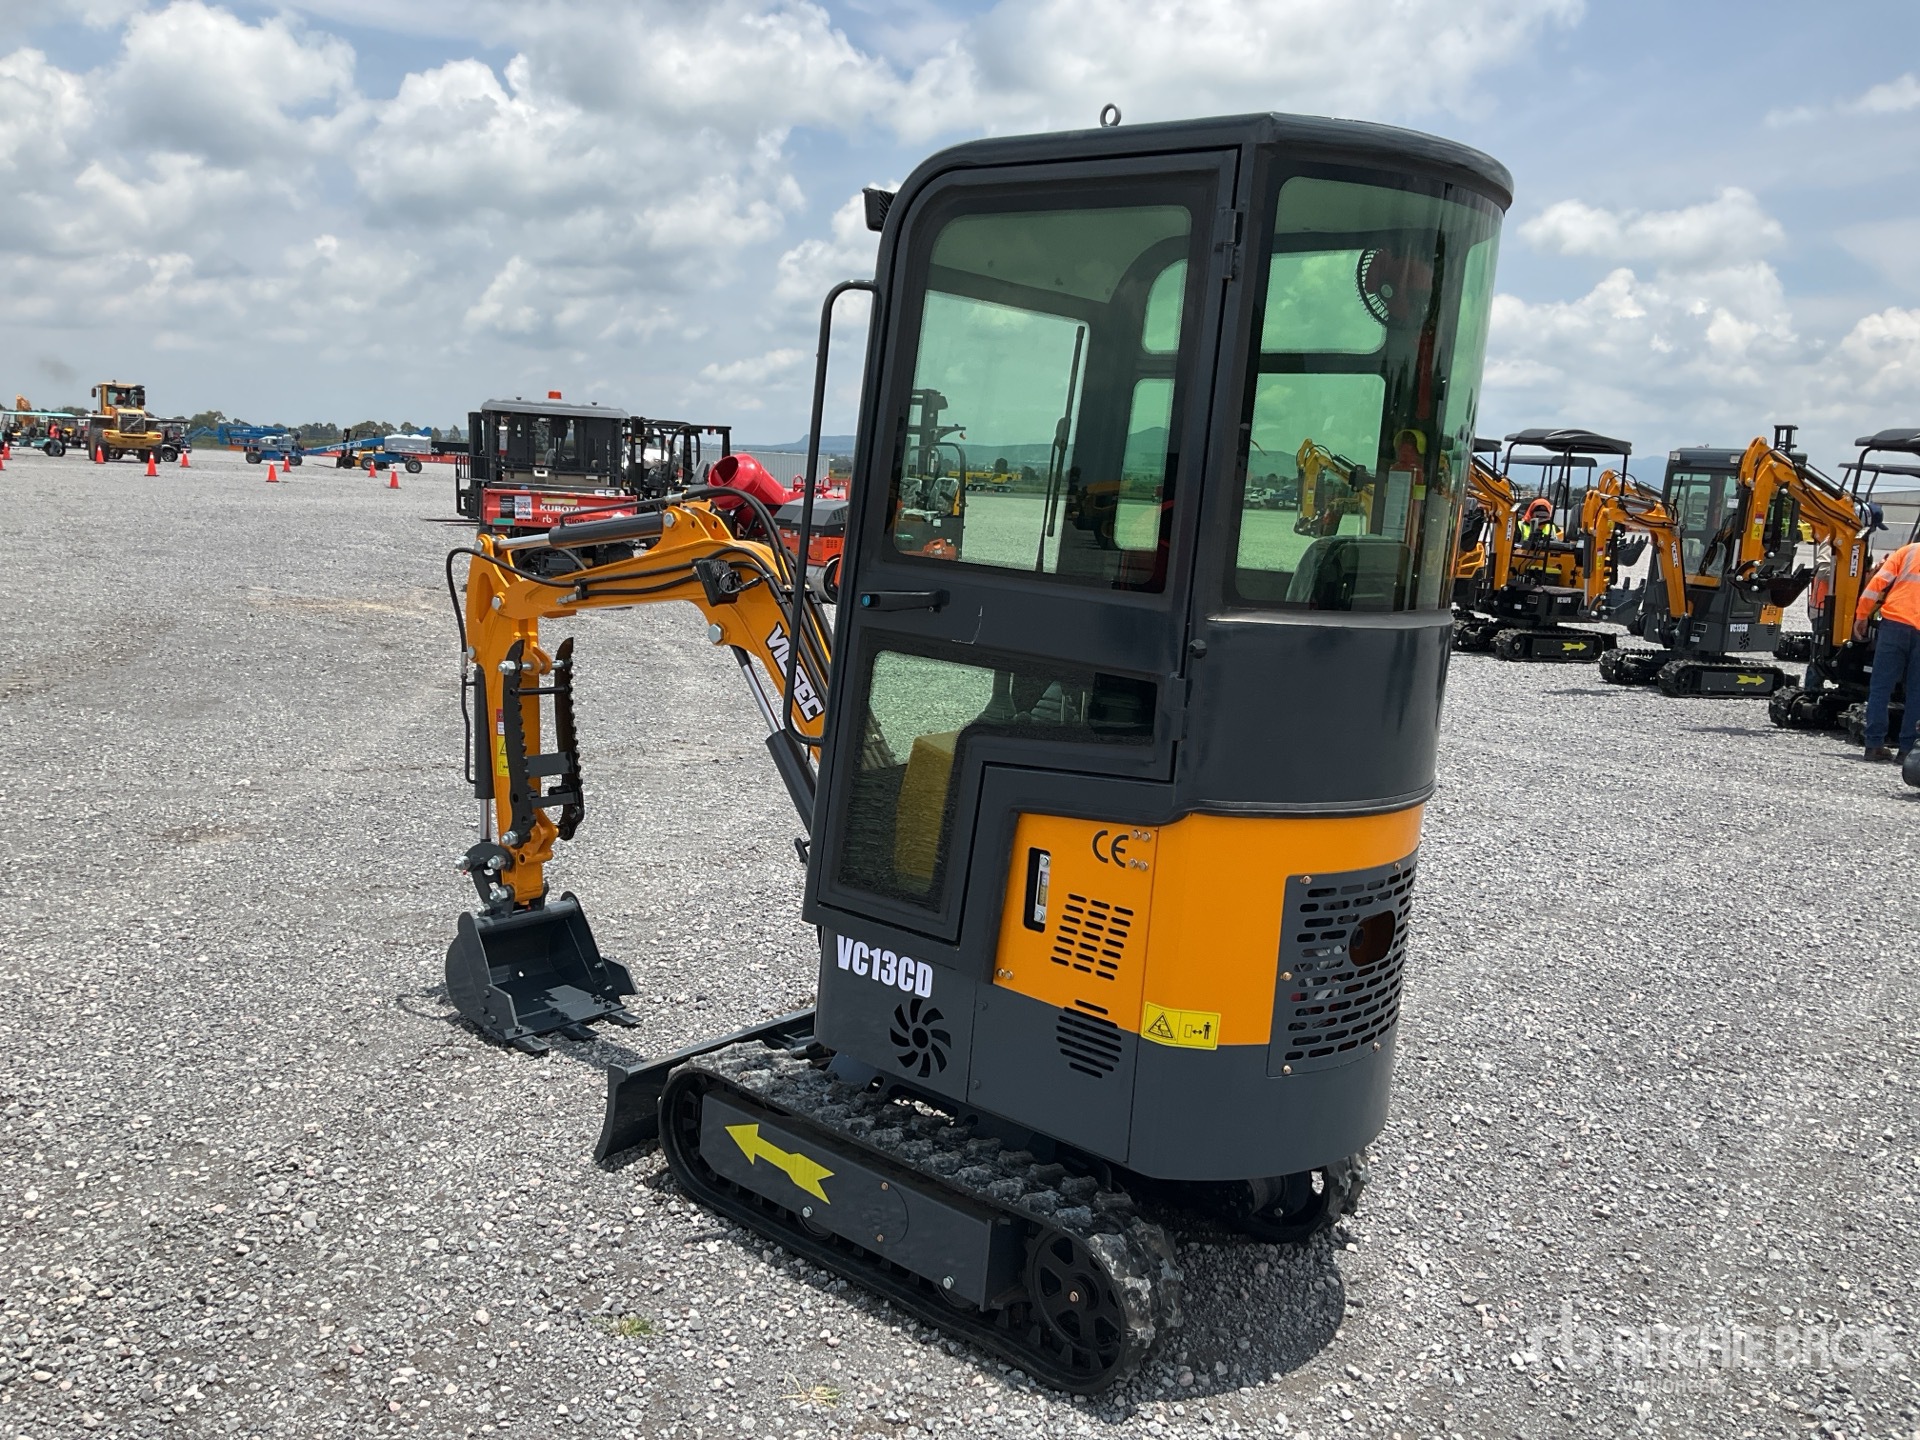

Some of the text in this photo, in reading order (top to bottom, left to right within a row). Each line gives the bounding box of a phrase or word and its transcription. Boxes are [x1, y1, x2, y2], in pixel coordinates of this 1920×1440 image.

[539, 504, 580, 513] KUBOTA
[1671, 541, 1679, 568] VICSEC
[1850, 544, 1861, 577] VICSEC
[1092, 830, 1130, 868] CE
[836, 934, 933, 998] VC13CD
